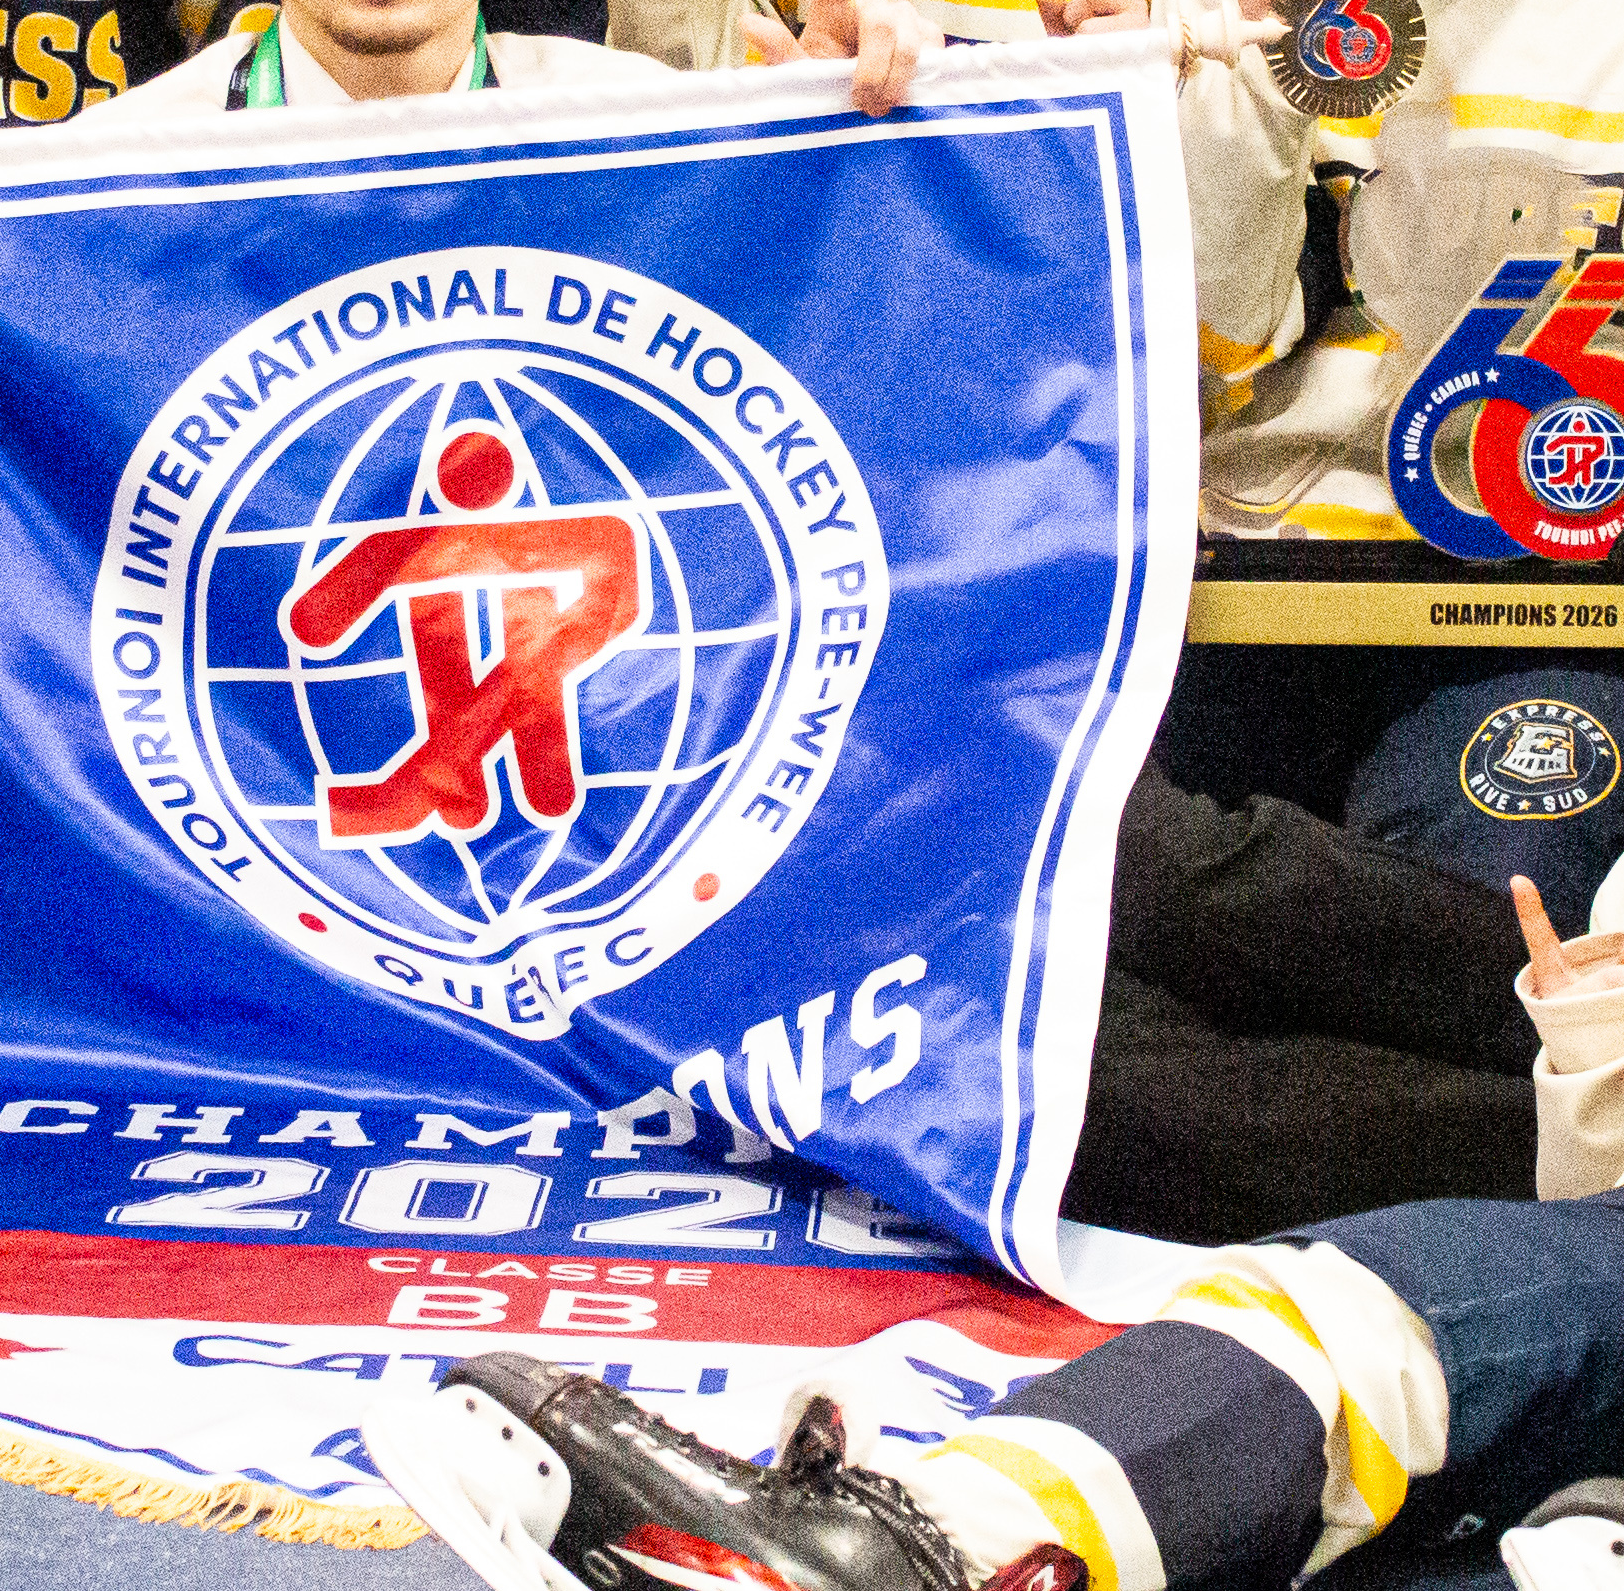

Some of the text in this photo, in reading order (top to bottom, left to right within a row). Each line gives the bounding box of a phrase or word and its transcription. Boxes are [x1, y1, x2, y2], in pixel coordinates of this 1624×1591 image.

[1430, 370, 1481, 406] CANADA
[1534, 520, 1597, 546] TOURNOI
[113, 267, 869, 885] TOURNOI INTERNATIONAL DE HOCKEY PEE-WEE
[1430, 603, 1557, 628] CHAMPIONS
[1562, 603, 1618, 628] 2026
[1490, 704, 1606, 742] EXPRESS
[1469, 772, 1589, 813] RIVE SUD
[368, 1255, 714, 1289] CLASSE
[386, 1284, 660, 1334] BB
